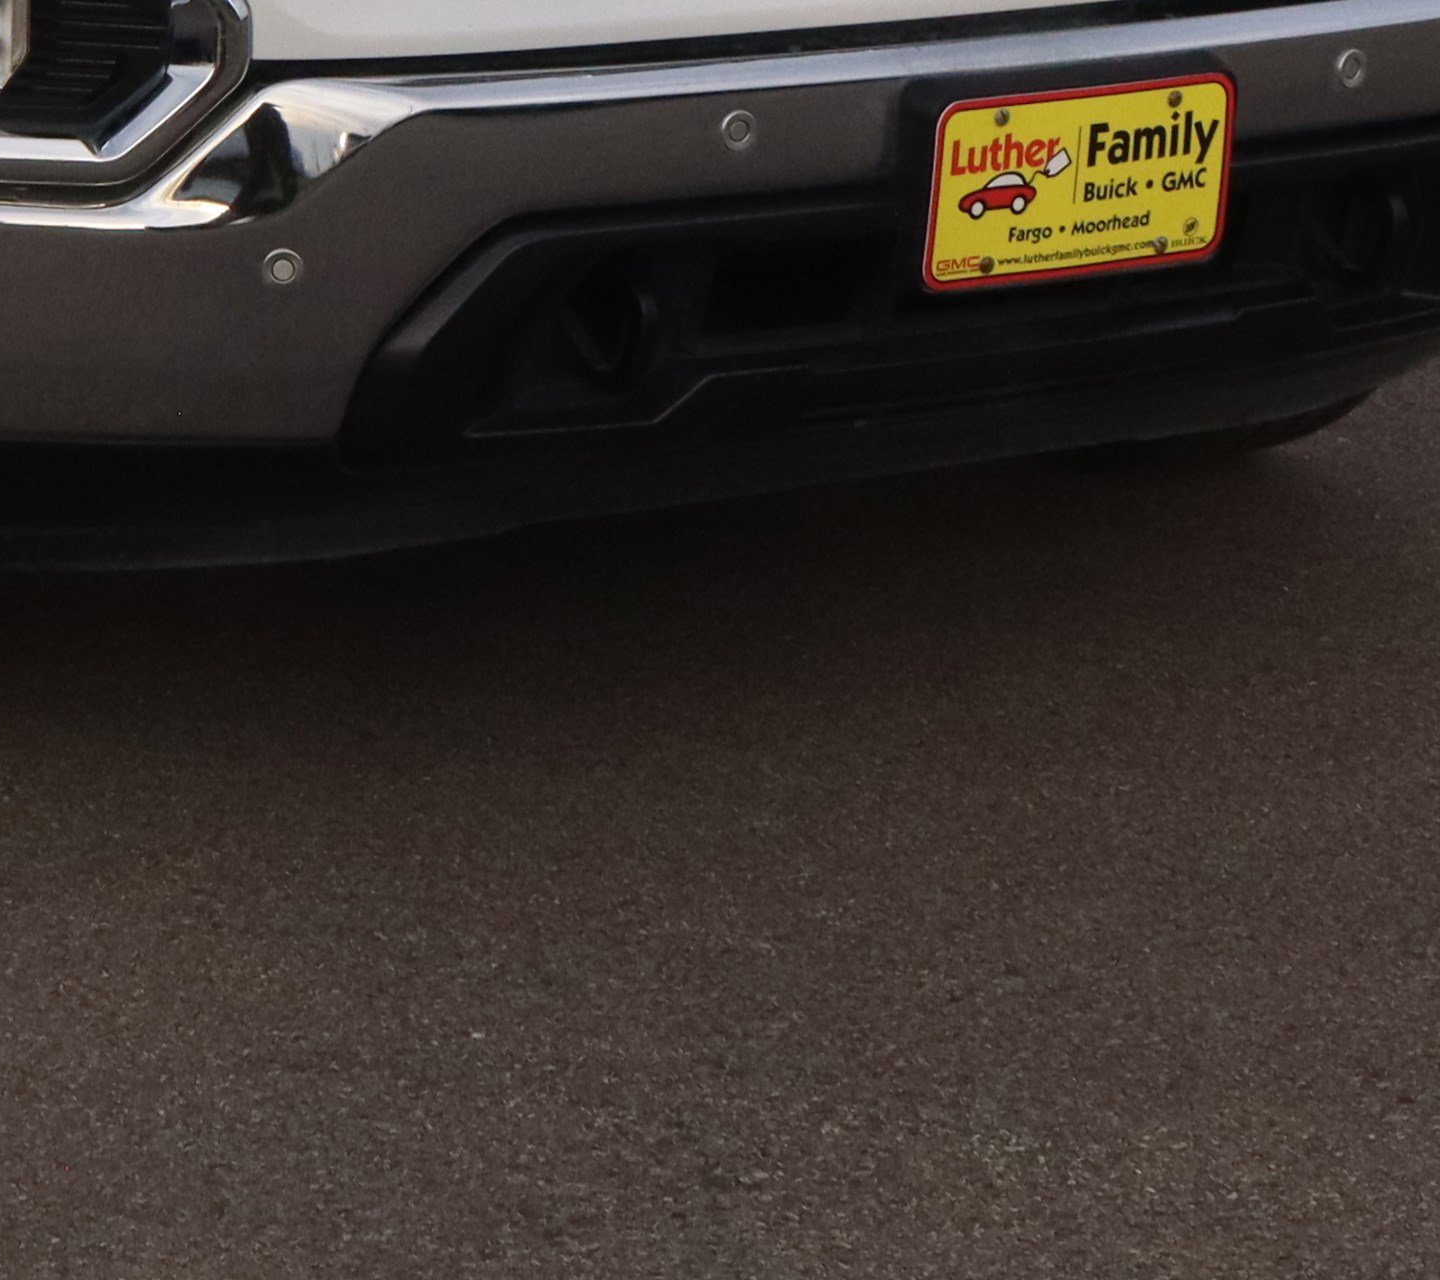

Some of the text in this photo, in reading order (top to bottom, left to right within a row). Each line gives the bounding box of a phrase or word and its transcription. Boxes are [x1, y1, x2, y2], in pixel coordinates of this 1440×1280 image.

[950, 133, 1061, 177] Luther
[1086, 110, 1220, 168] Family
[1083, 167, 1208, 204] Buick GMC
[1007, 210, 1151, 244] Fargo Moorhead
[935, 255, 982, 272] GMC
